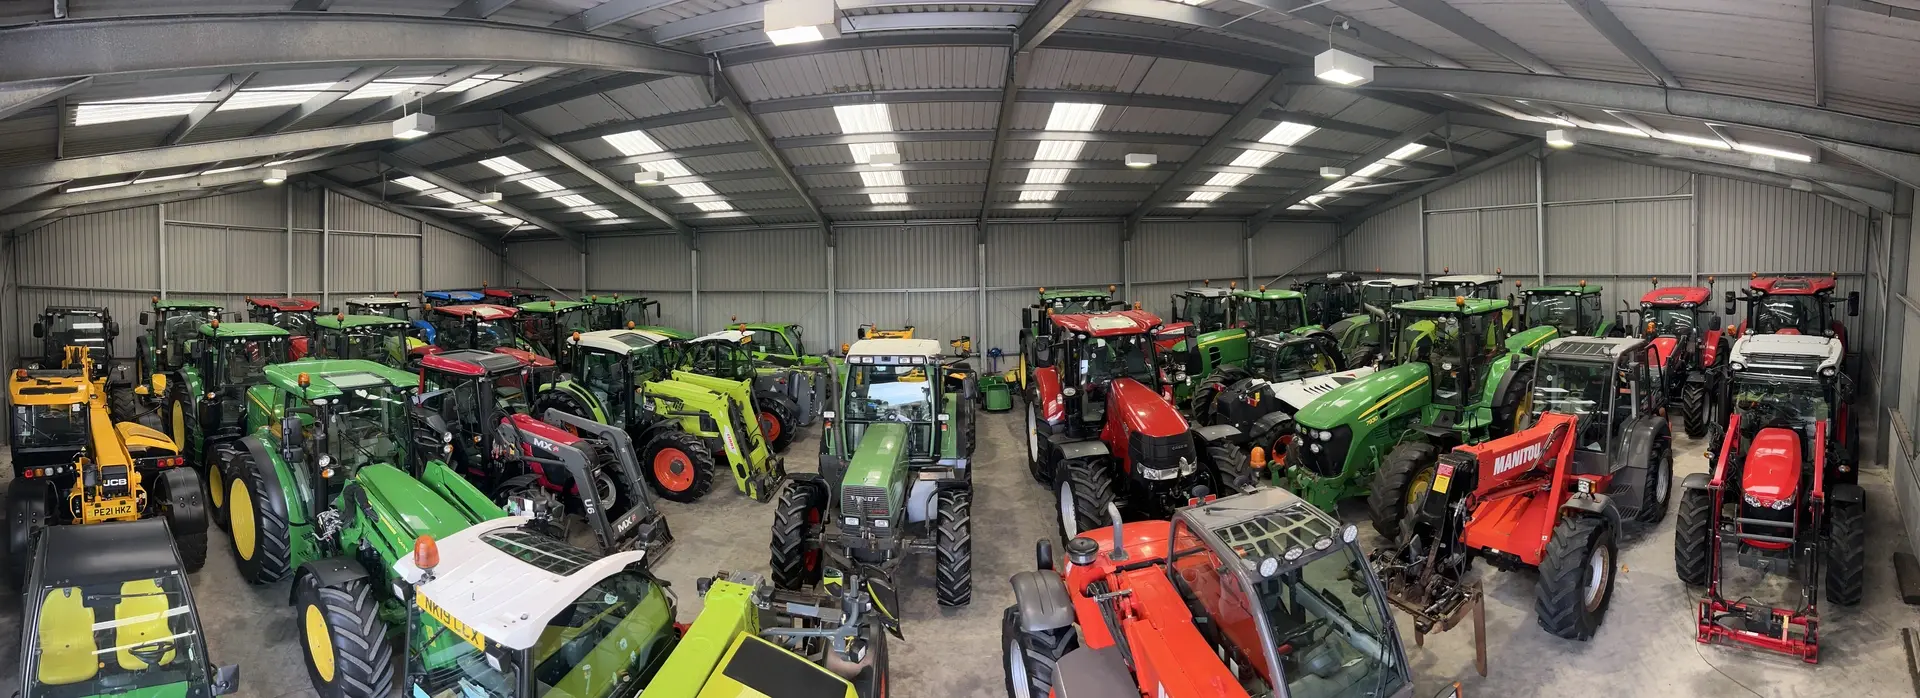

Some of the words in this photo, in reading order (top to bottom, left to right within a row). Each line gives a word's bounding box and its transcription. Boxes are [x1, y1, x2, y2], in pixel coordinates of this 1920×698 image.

[533, 437, 552, 451] MX
[1493, 442, 1542, 475] MANITOU
[103, 478, 127, 487] JCB
[94, 507, 113, 517] PE21
[115, 505, 132, 515] HKZ
[584, 498, 595, 515] U6
[617, 516, 634, 533] MX
[425, 596, 451, 625] NK19
